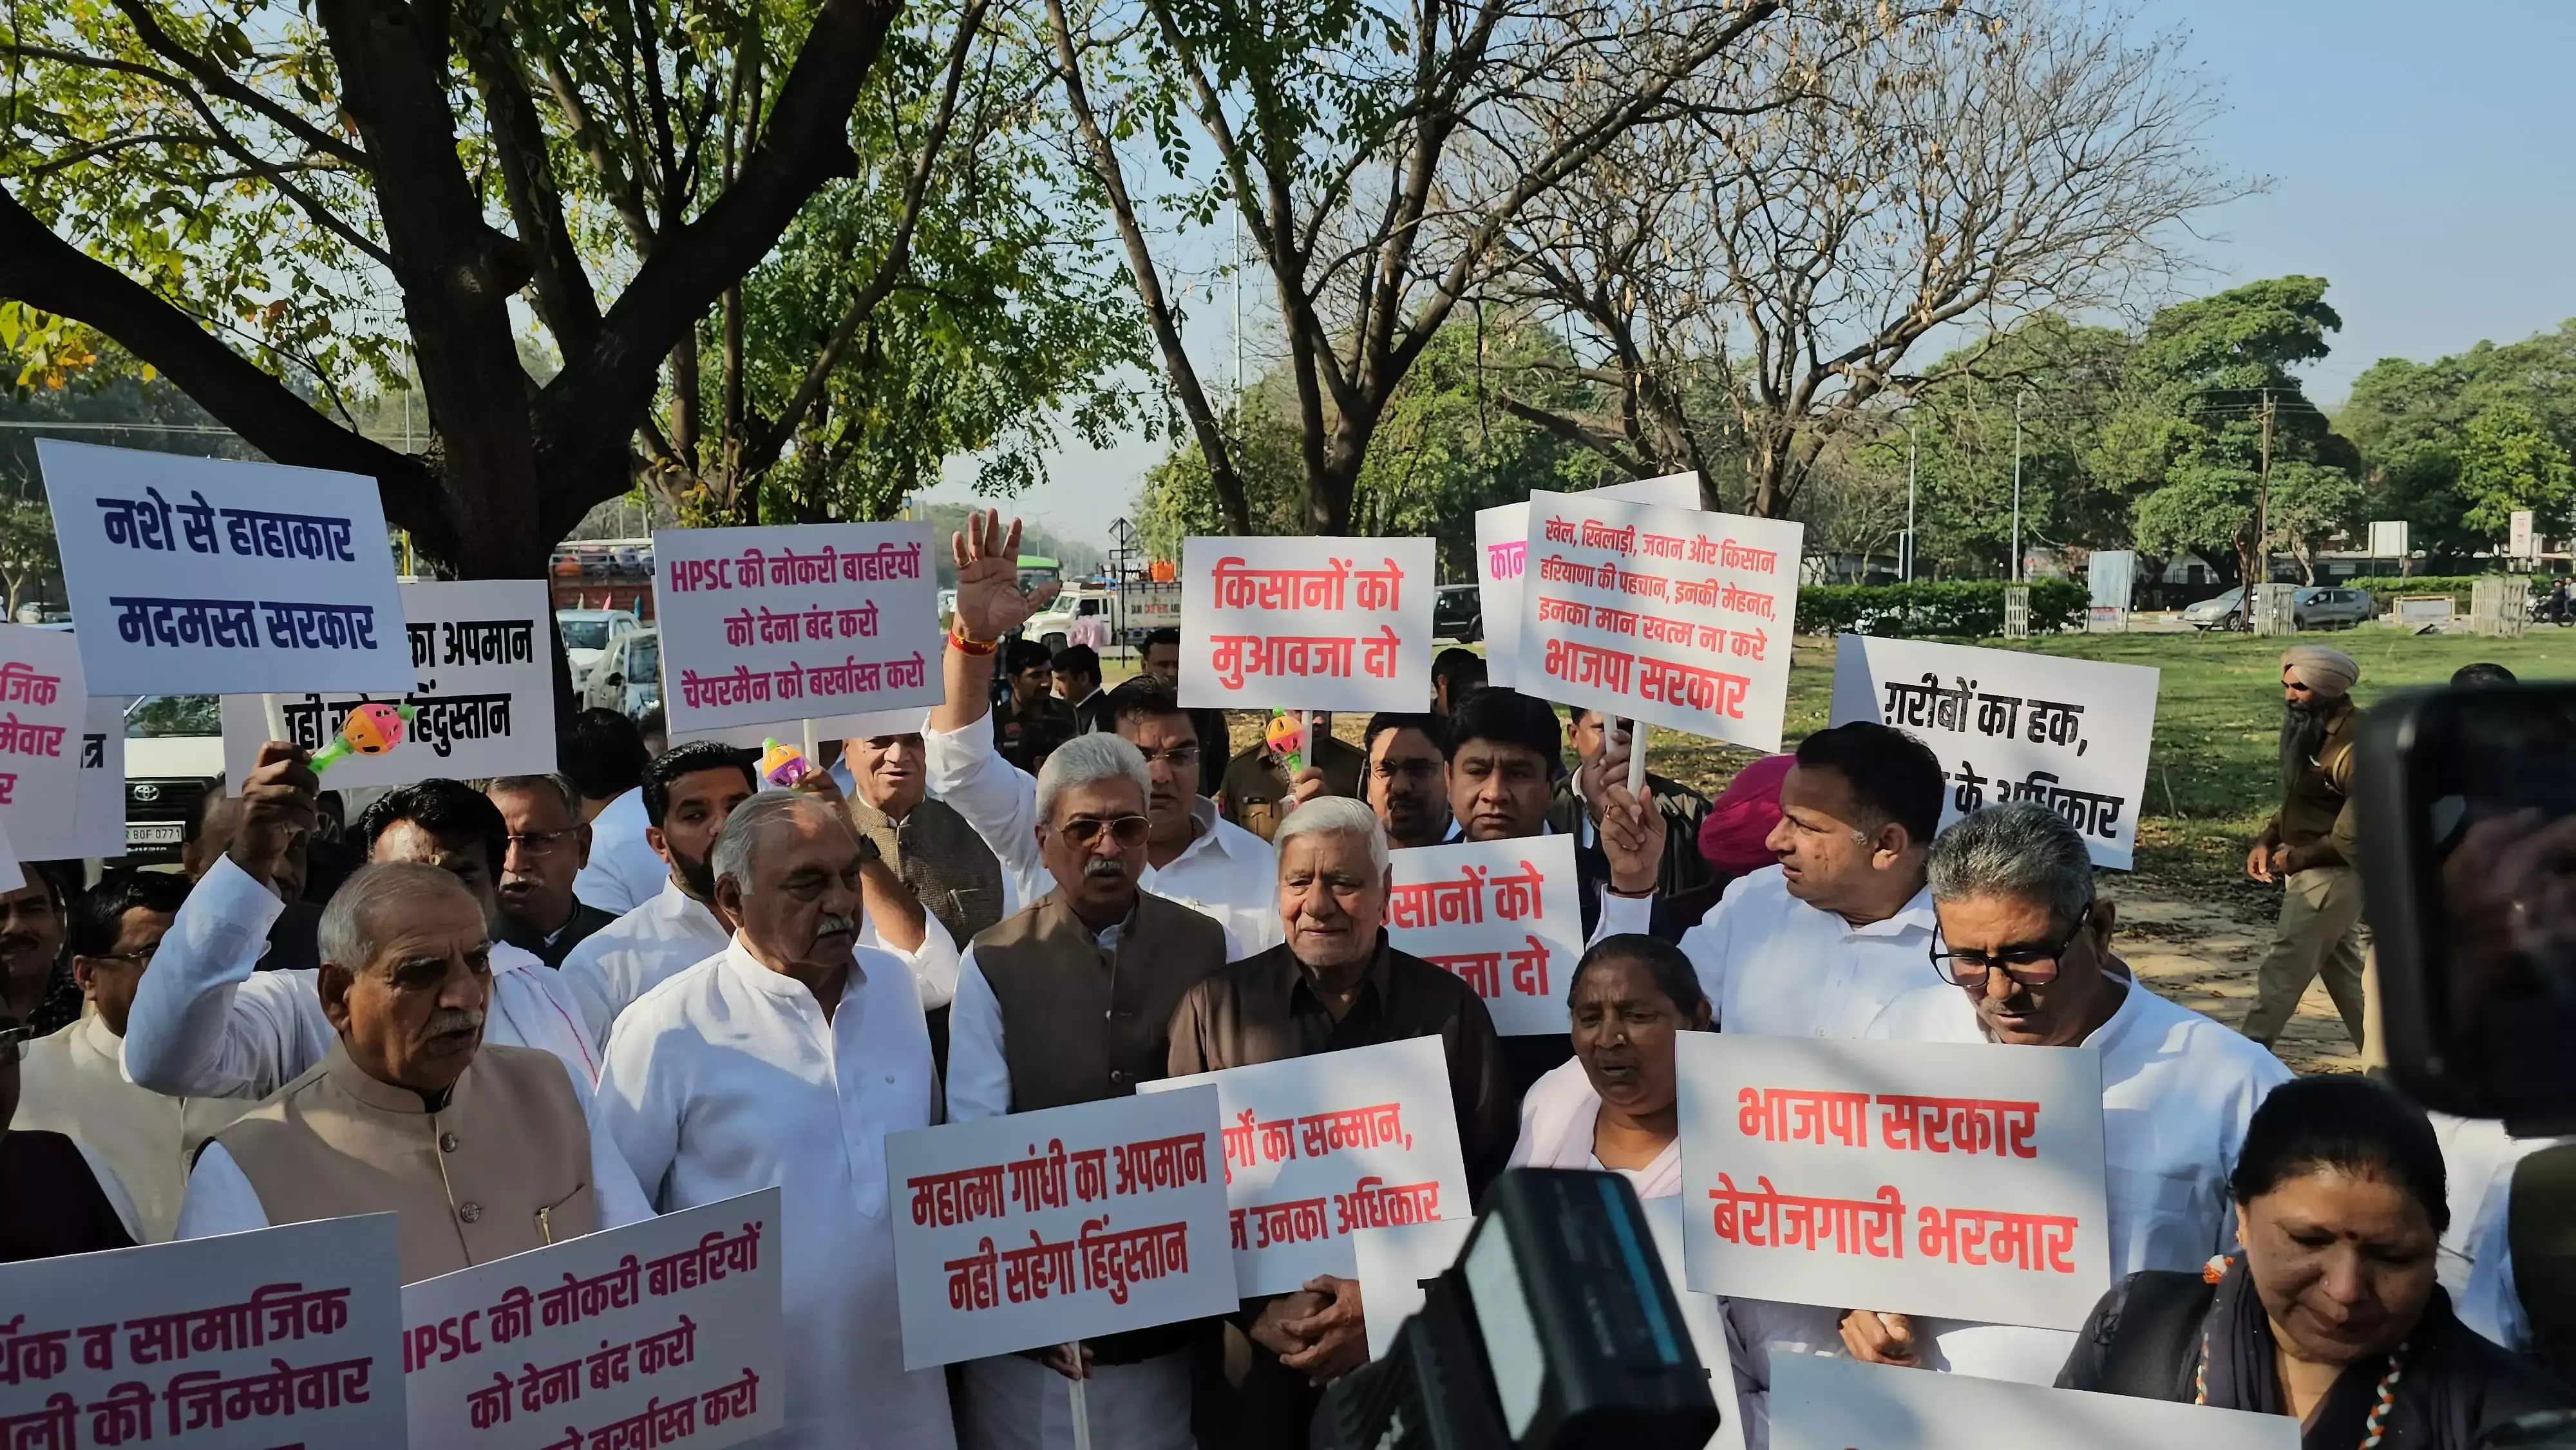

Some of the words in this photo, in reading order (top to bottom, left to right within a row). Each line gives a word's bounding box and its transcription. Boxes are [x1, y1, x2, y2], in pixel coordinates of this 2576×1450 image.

[96, 487, 176, 551] नशे
[176, 491, 220, 554] से
[220, 509, 355, 561] हाहाकार
[1546, 515, 1577, 548] खेल,
[1582, 520, 1637, 558] खिलाड़ी,
[1642, 534, 1685, 560] जवान
[1688, 534, 1718, 565] और
[1721, 539, 1777, 574] किसान
[671, 559, 732, 592] HPSC
[735, 549, 765, 588] की
[768, 545, 837, 585] नोकरी
[840, 542, 921, 581] बाहरियों
[1211, 557, 1352, 610] किसानों
[1354, 558, 1404, 611] को
[1488, 541, 1527, 580] कान
[1540, 554, 1596, 587] हरियाणा
[1597, 562, 1616, 590] की
[1618, 571, 1669, 603] पहचान,
[1675, 578, 1719, 607] इनकी
[1721, 582, 1776, 622] मेहनत,
[109, 597, 259, 647] मदमस्त
[259, 601, 377, 649] सरकार
[443, 620, 533, 666] अपमान
[724, 608, 754, 646] को
[757, 606, 800, 643] देना
[802, 604, 833, 640] बंद
[837, 599, 878, 637] करो
[1540, 598, 1593, 628] इनका
[1595, 607, 1639, 636] मान
[1642, 615, 1695, 646] खत्म
[1699, 625, 1727, 653] ना
[1730, 628, 1767, 661] करे
[681, 665, 771, 708] चैयरमैन
[774, 661, 804, 699] को
[884, 651, 924, 689] करो
[1211, 636, 1356, 690] मुआवजा
[1362, 625, 1401, 677] दो
[1546, 639, 1634, 694] भाजपा
[1638, 656, 1750, 719] सरकार
[404, 679, 511, 757] हिंदुस्तान
[1978, 693, 2022, 739] का
[2027, 699, 2087, 757] हक,
[1955, 760, 1987, 815] के
[156, 829, 179, 838] 0771
[1490, 861, 1543, 921] को
[1507, 936, 1549, 995] दो
[1258, 1118, 1296, 1162] का
[1298, 1103, 1412, 1157] सम्मान,
[1738, 1088, 1870, 1147] भाजपा
[1876, 1095, 2040, 1158] सरकार
[907, 1165, 1005, 1228] महात्मा
[1008, 1138, 1068, 1212] गांधी
[1071, 1149, 1107, 1202] का
[1113, 1133, 1206, 1194] अपमान
[1249, 1198, 1329, 1248] उनका
[1334, 1177, 1441, 1234] अधिकार
[1709, 1172, 1906, 1258] बेरोजगारी
[1918, 1207, 2078, 1273] भरमार
[488, 1286, 534, 1344] की
[538, 1254, 641, 1326] नोकरी
[645, 1221, 762, 1295] बाहरियों
[944, 1236, 999, 1311] नही
[1001, 1230, 1075, 1303] सहेगा
[1078, 1214, 1188, 1304] हिंदुस्तान
[77, 1324, 117, 1370] व
[124, 1283, 350, 1364] सामाजिक
[87, 1382, 155, 1446] की
[162, 1357, 372, 1435] जिम्मेवार
[467, 1372, 513, 1429] को
[518, 1361, 582, 1412] देना
[586, 1340, 631, 1389] बंद
[636, 1315, 696, 1374] करो
[701, 1368, 759, 1426] करो
